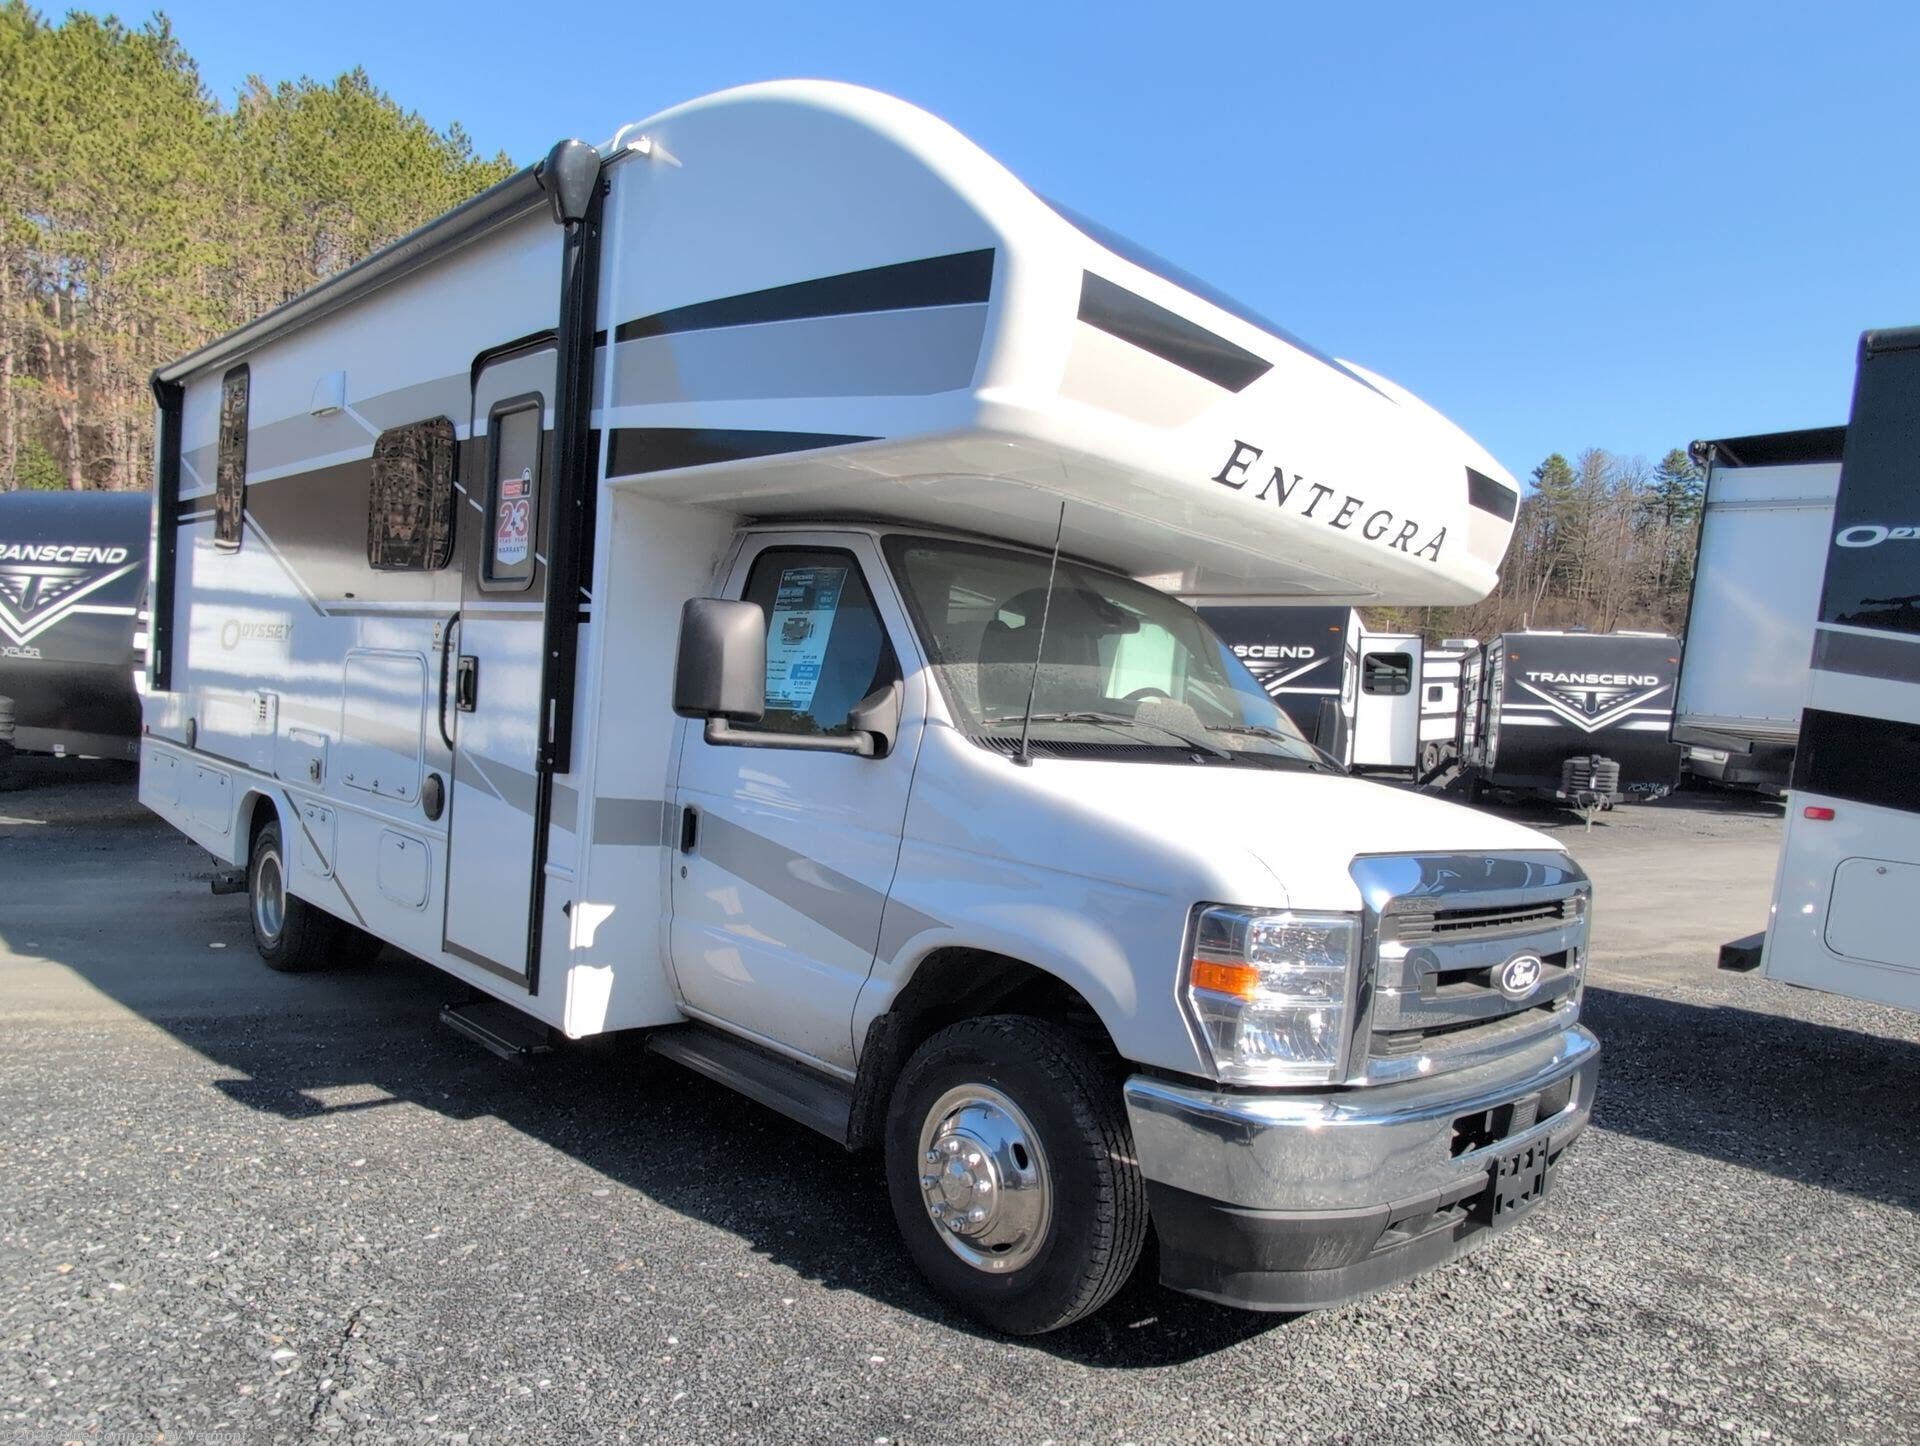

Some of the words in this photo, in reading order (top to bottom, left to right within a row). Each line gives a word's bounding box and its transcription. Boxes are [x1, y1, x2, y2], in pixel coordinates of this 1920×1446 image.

[1211, 439, 1447, 562] ENTEGRA
[221, 618, 294, 652] ODYSSEY
[1229, 645, 1315, 658] SCEND
[1526, 672, 1659, 685] TRANSCEND
